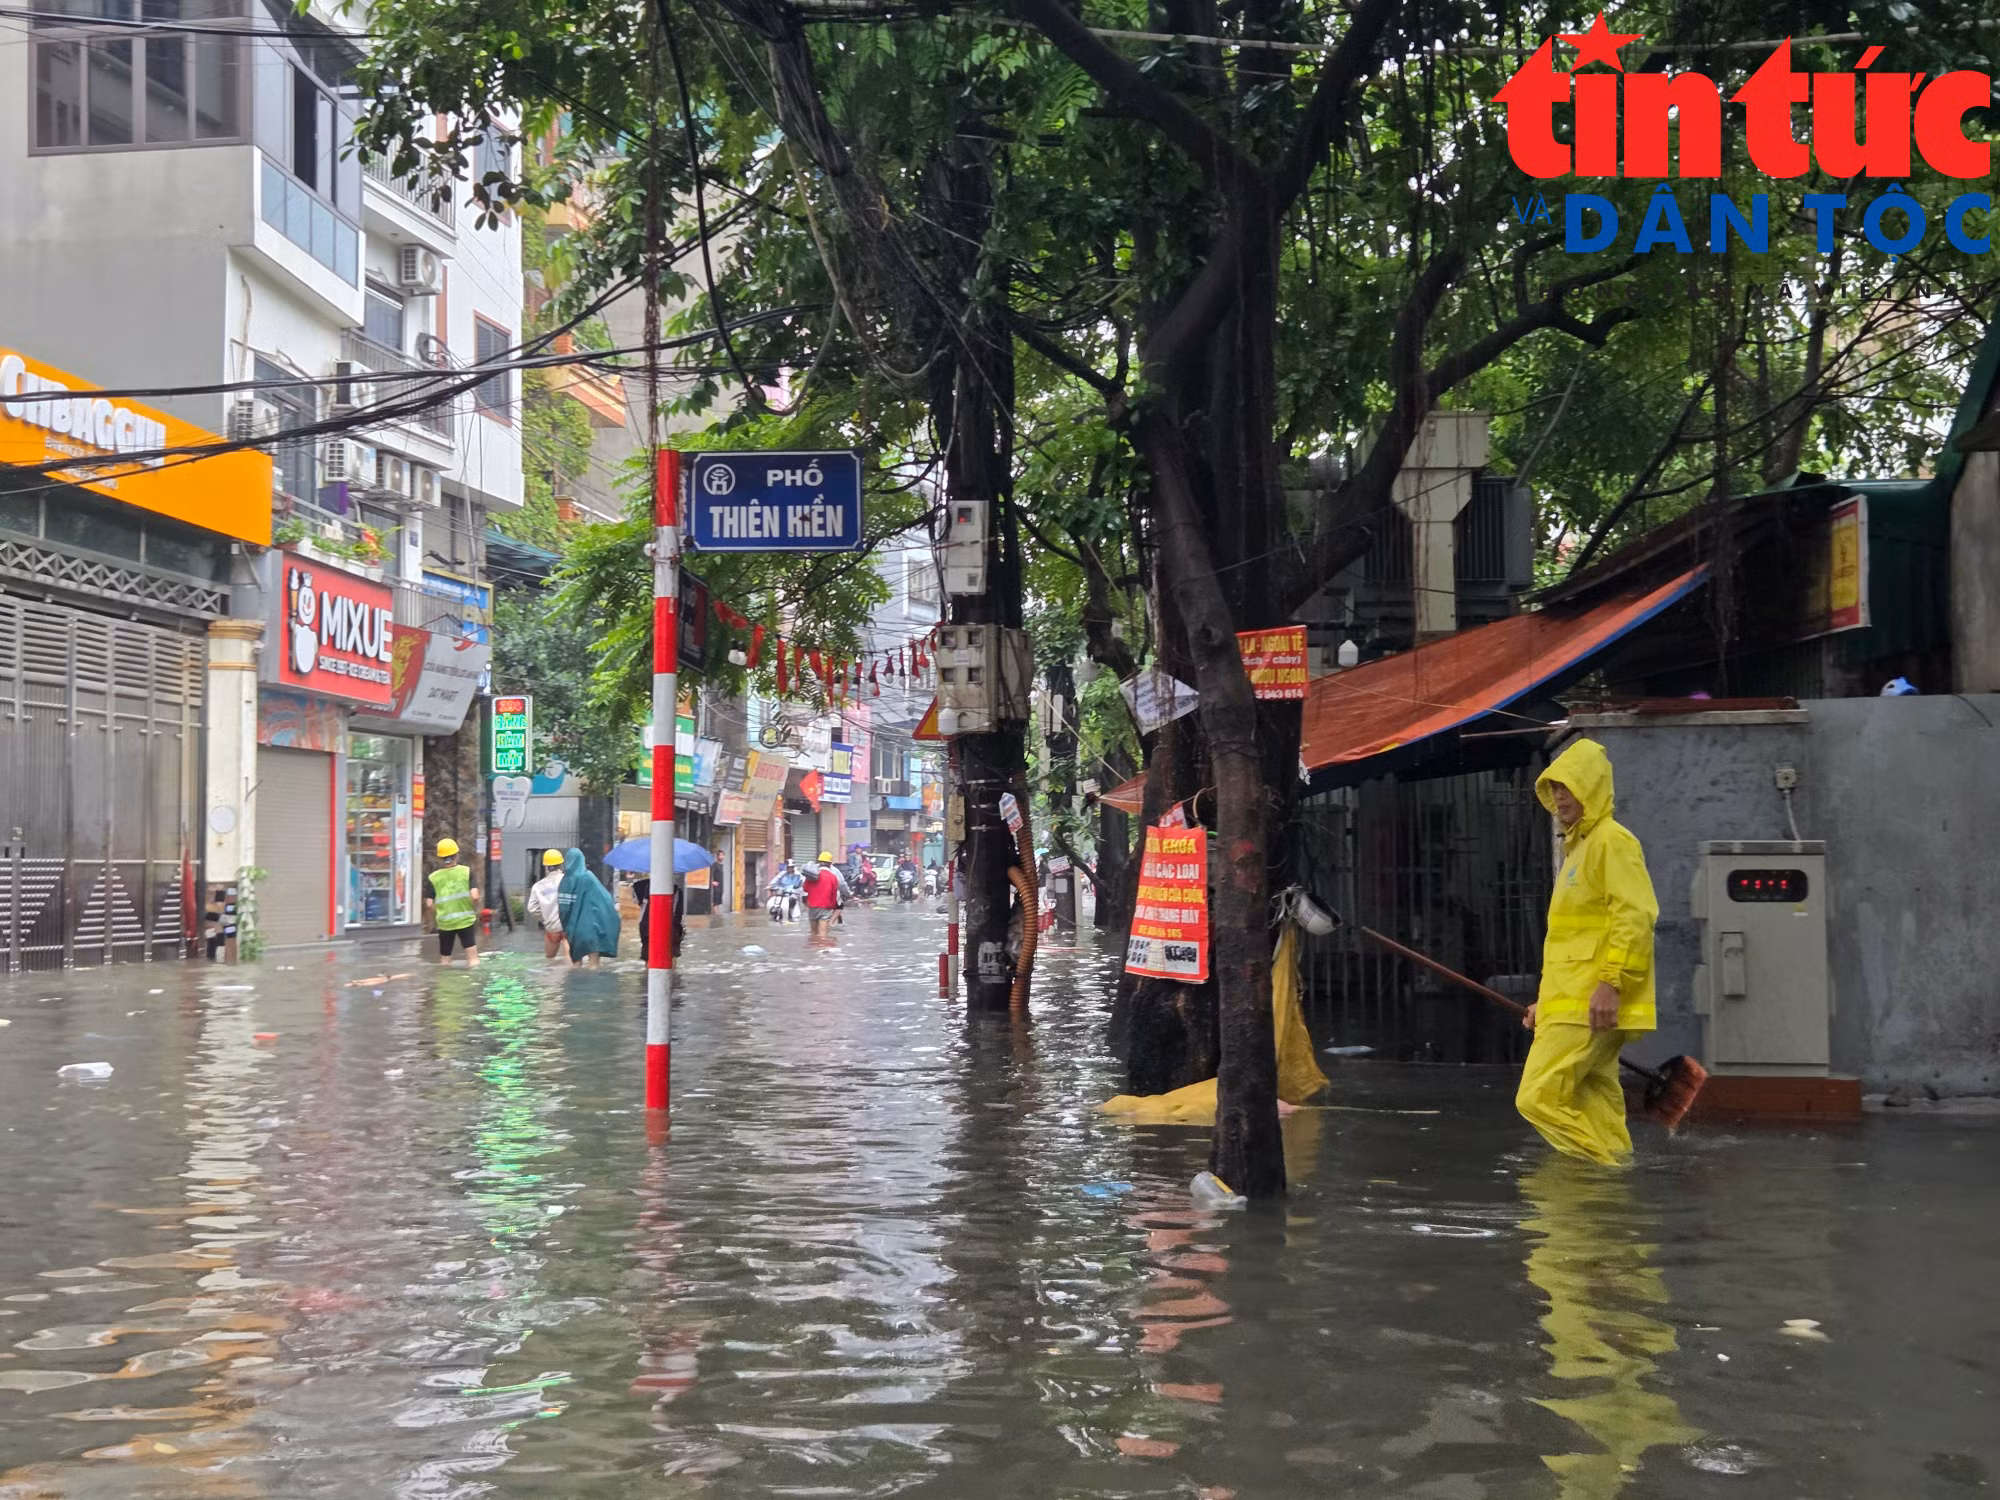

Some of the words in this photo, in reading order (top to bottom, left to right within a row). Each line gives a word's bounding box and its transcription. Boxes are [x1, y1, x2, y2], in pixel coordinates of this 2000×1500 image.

[766, 458, 825, 487] PHỐ
[709, 498, 780, 539] THIÊN
[786, 493, 844, 538] HIỀN
[321, 590, 393, 663] MIXUE
[1162, 836, 1197, 854] KHÓA
[1176, 864, 1199, 883] LOẠI
